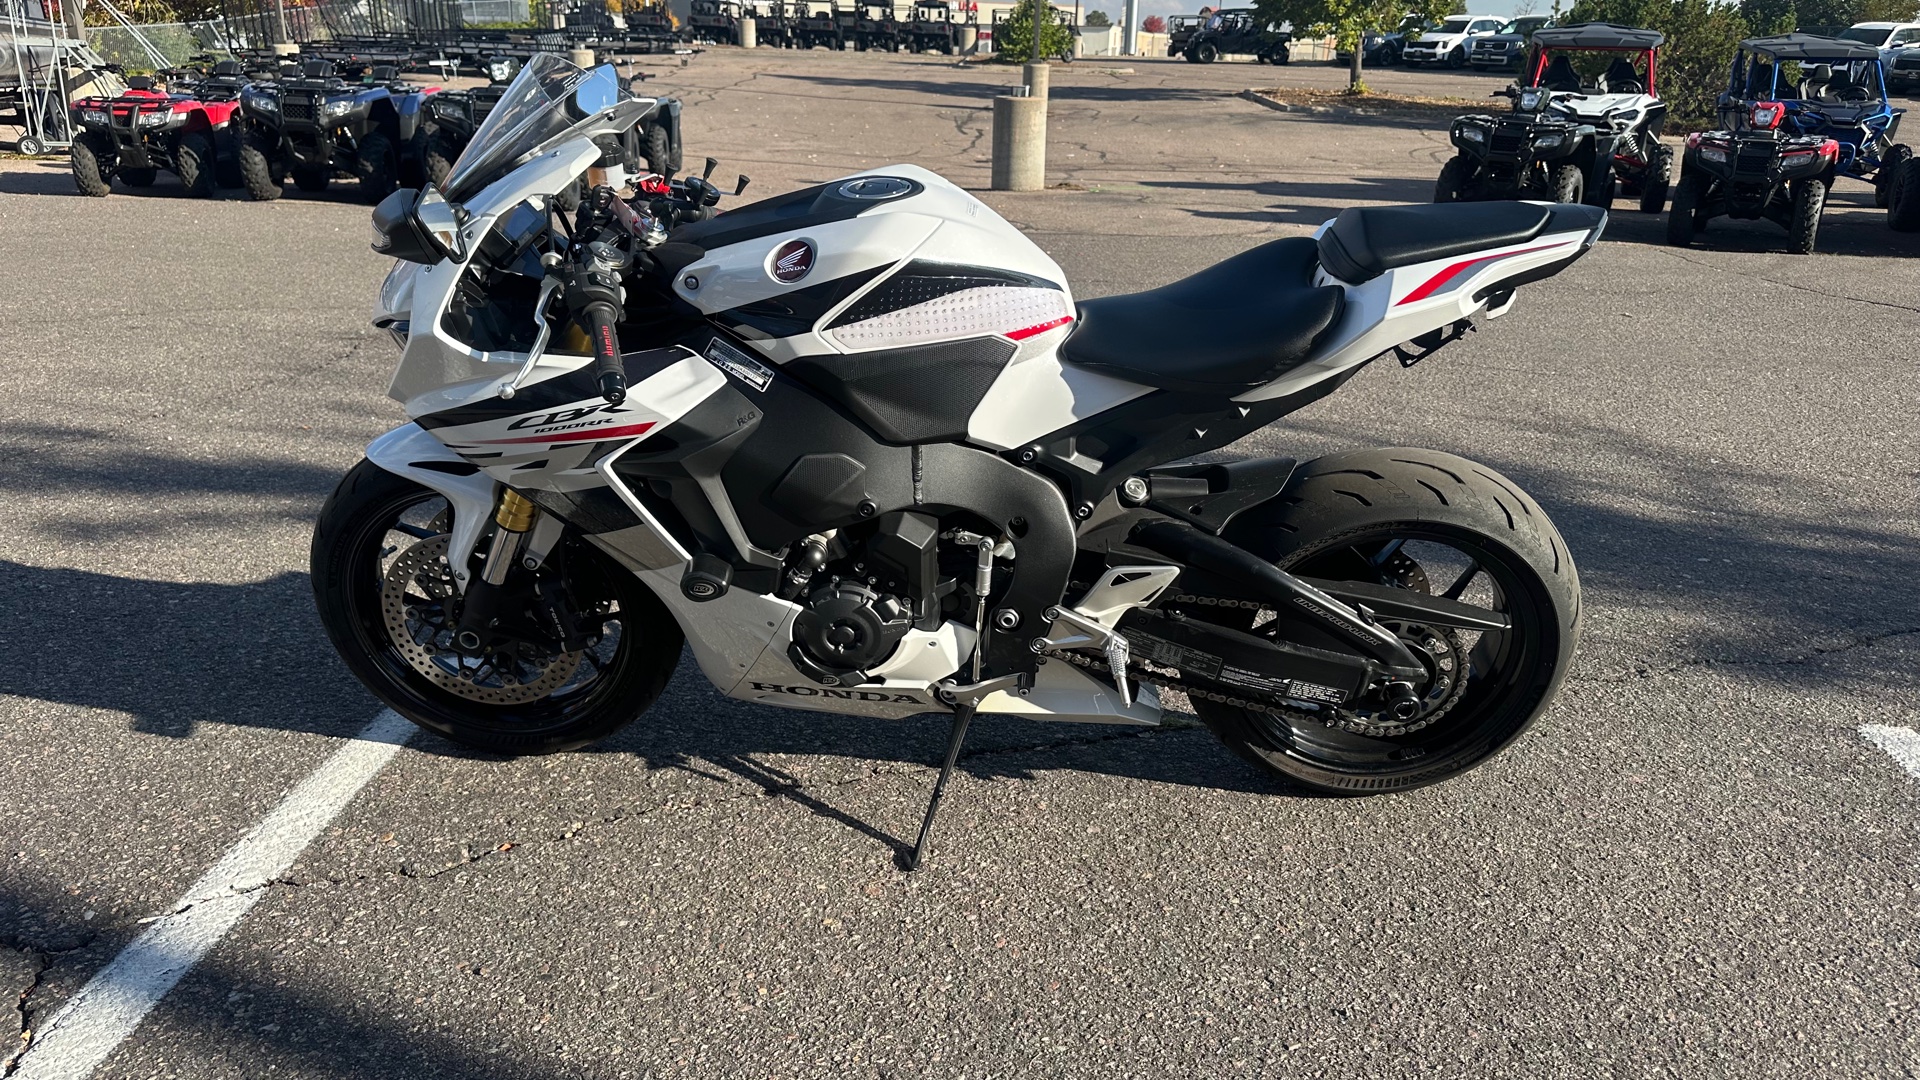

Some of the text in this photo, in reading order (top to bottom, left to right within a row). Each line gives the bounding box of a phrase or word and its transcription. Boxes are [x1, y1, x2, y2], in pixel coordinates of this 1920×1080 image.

[776, 265, 807, 275] HONDA
[507, 399, 634, 431] CBR
[533, 418, 616, 434] 1000RR
[549, 606, 566, 638] TOKICO
[748, 681, 927, 705] HONDA
